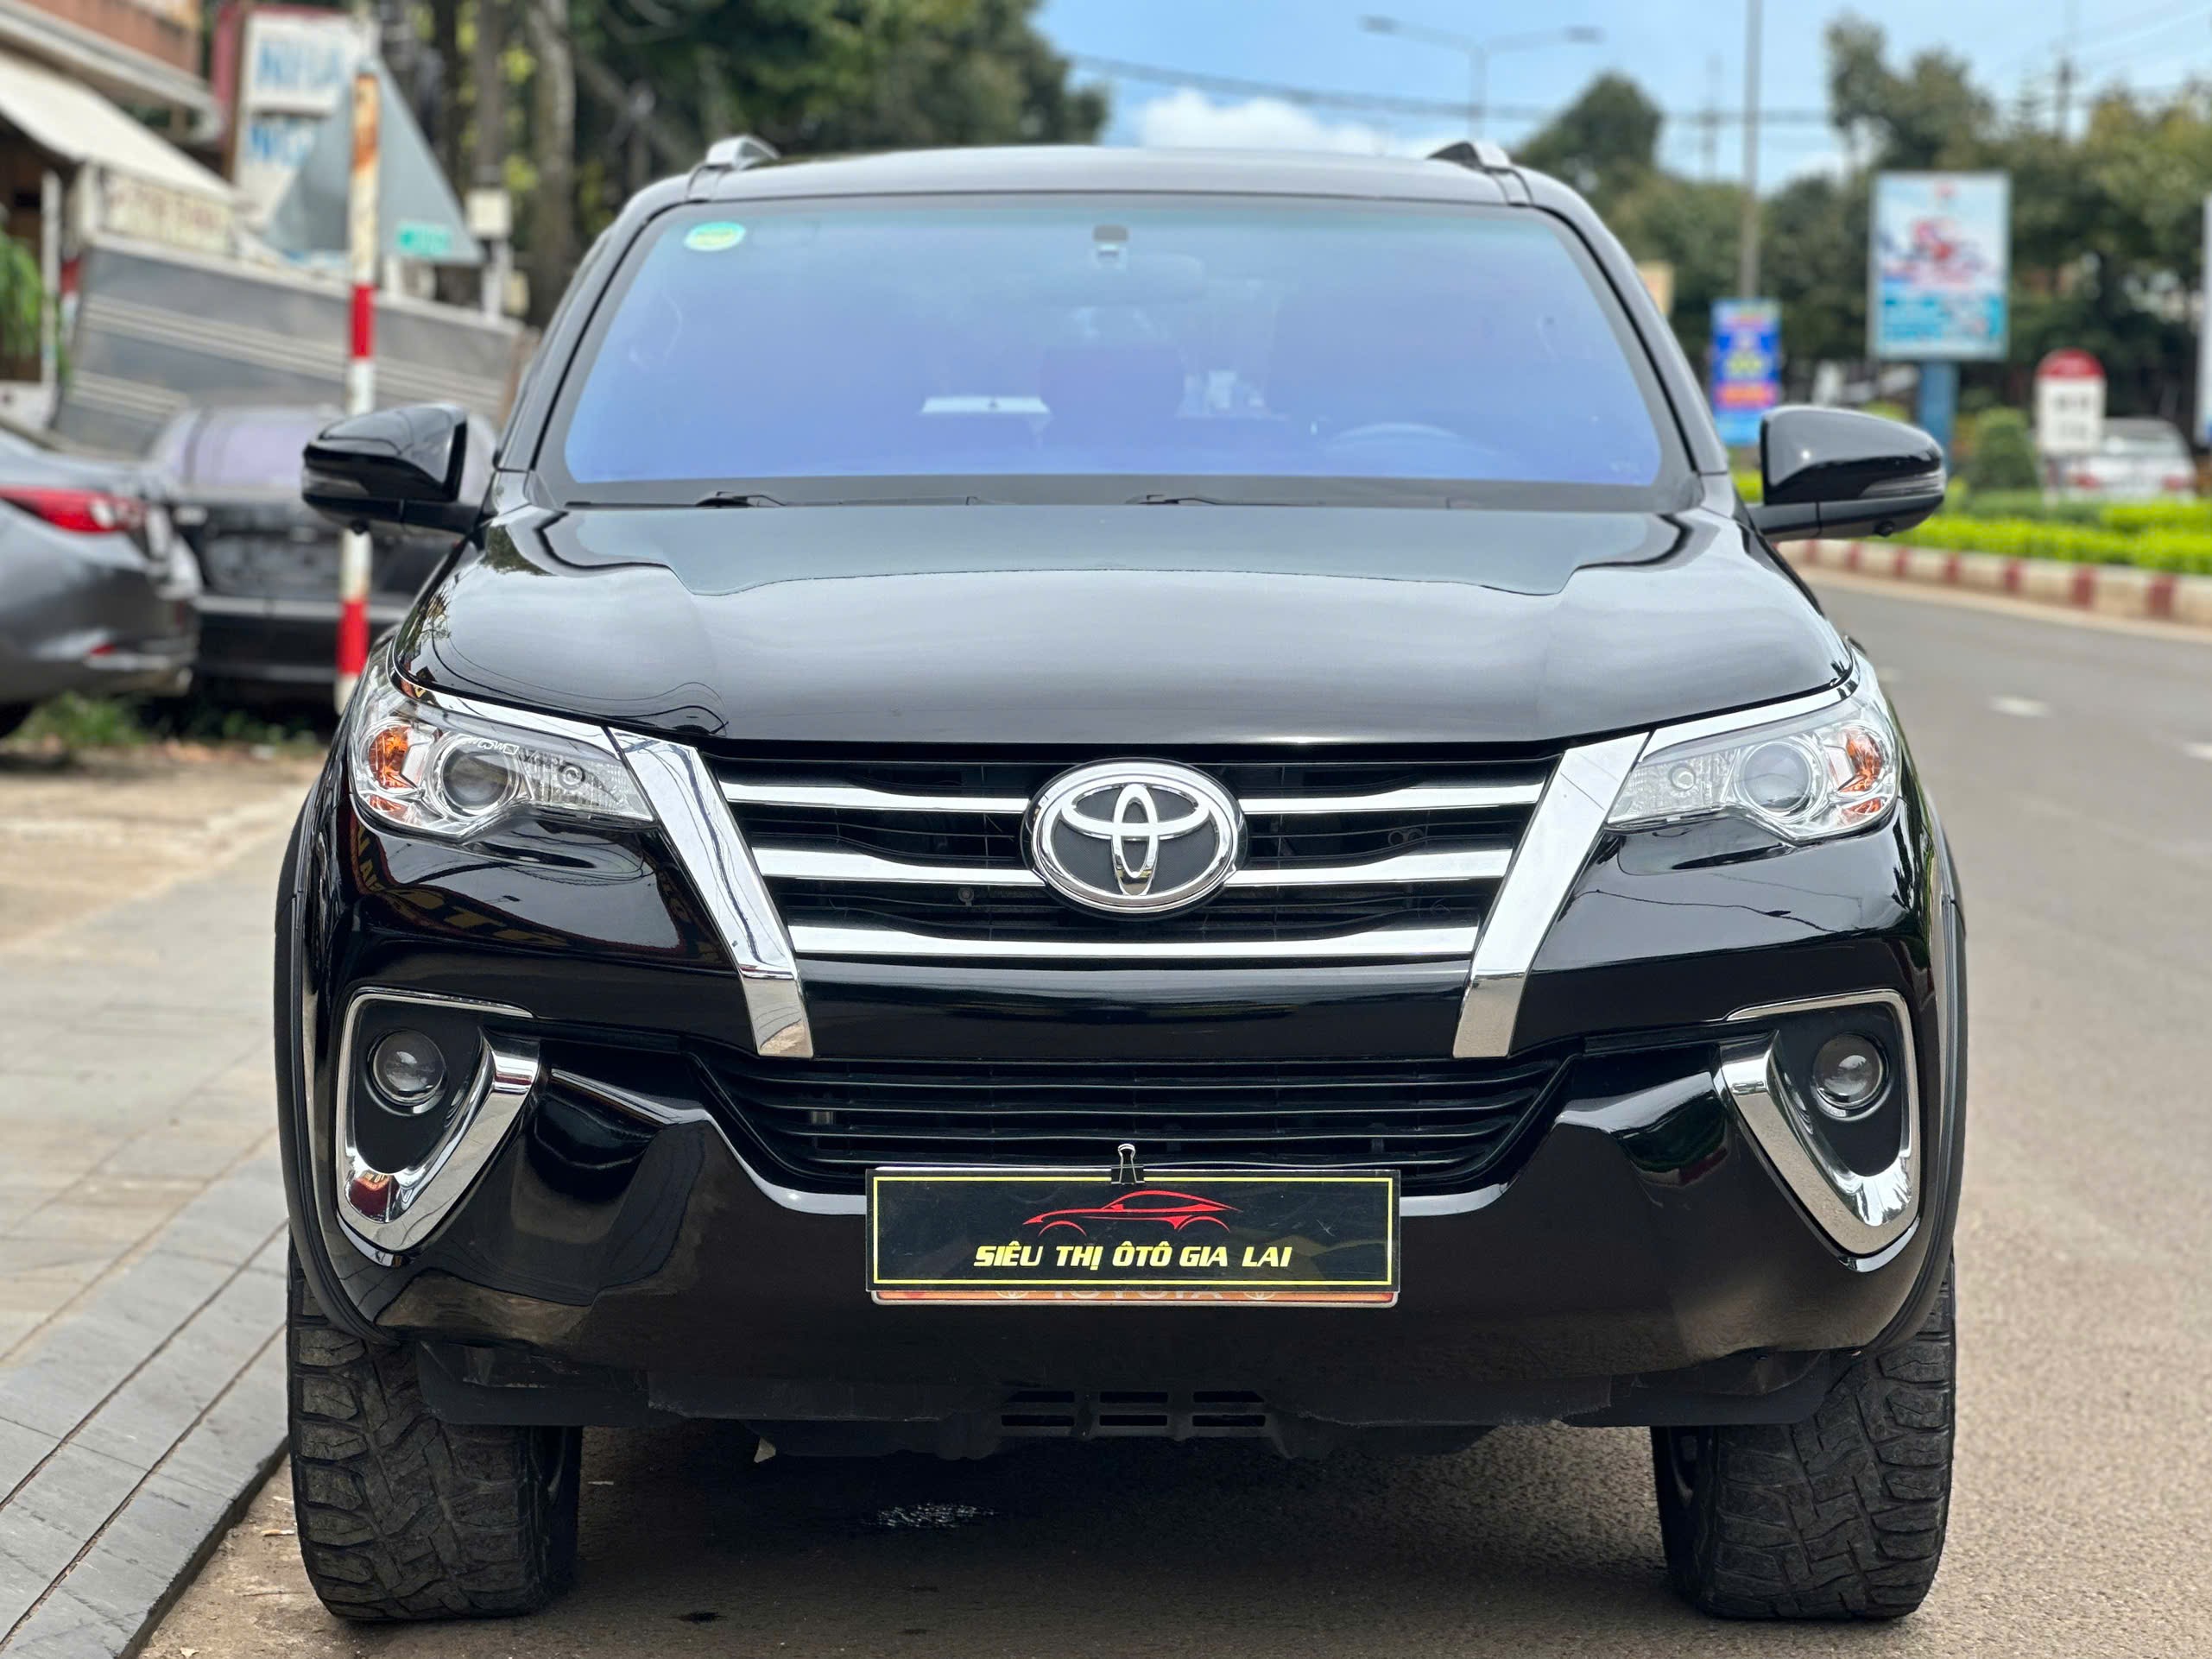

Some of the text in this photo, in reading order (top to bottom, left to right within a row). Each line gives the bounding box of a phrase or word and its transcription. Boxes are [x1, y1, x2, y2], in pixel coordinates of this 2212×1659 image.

[973, 1240, 1292, 1271] SIÊU THỊ ÔTÔ GIA LAI
